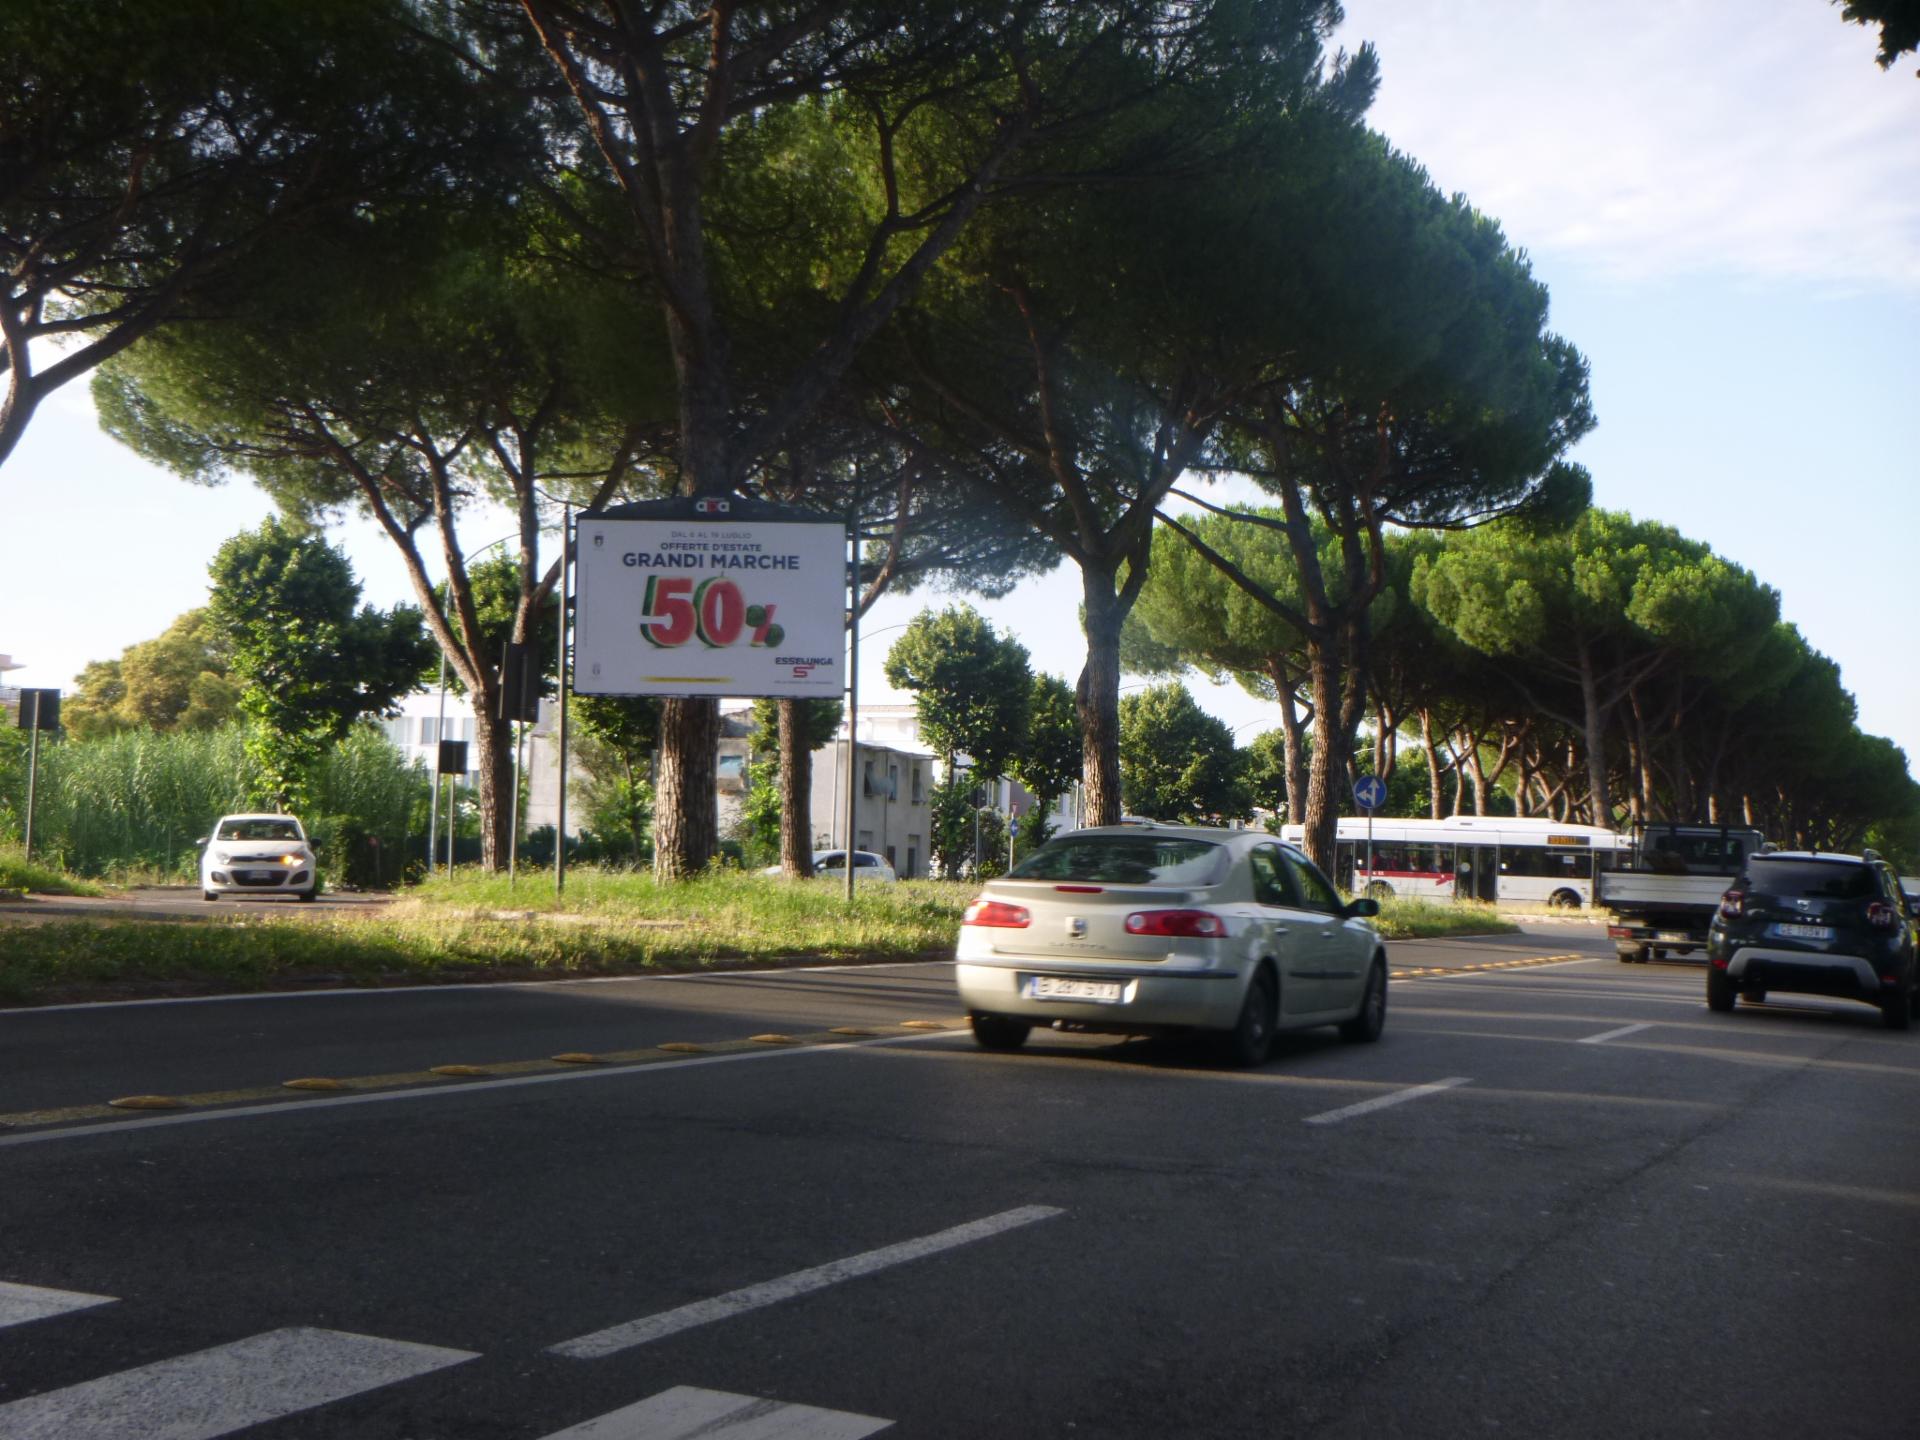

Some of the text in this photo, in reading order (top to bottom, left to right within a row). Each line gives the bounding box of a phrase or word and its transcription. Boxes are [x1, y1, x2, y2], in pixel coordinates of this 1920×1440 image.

[697, 531, 708, 539] AL
[721, 532, 753, 540] LUGLIO
[661, 542, 762, 552] OFFERTE D'ESTATE
[622, 552, 800, 570] GRANDI MARCHE
[640, 574, 786, 649] 50%
[775, 656, 833, 666] ESSELUNGA
